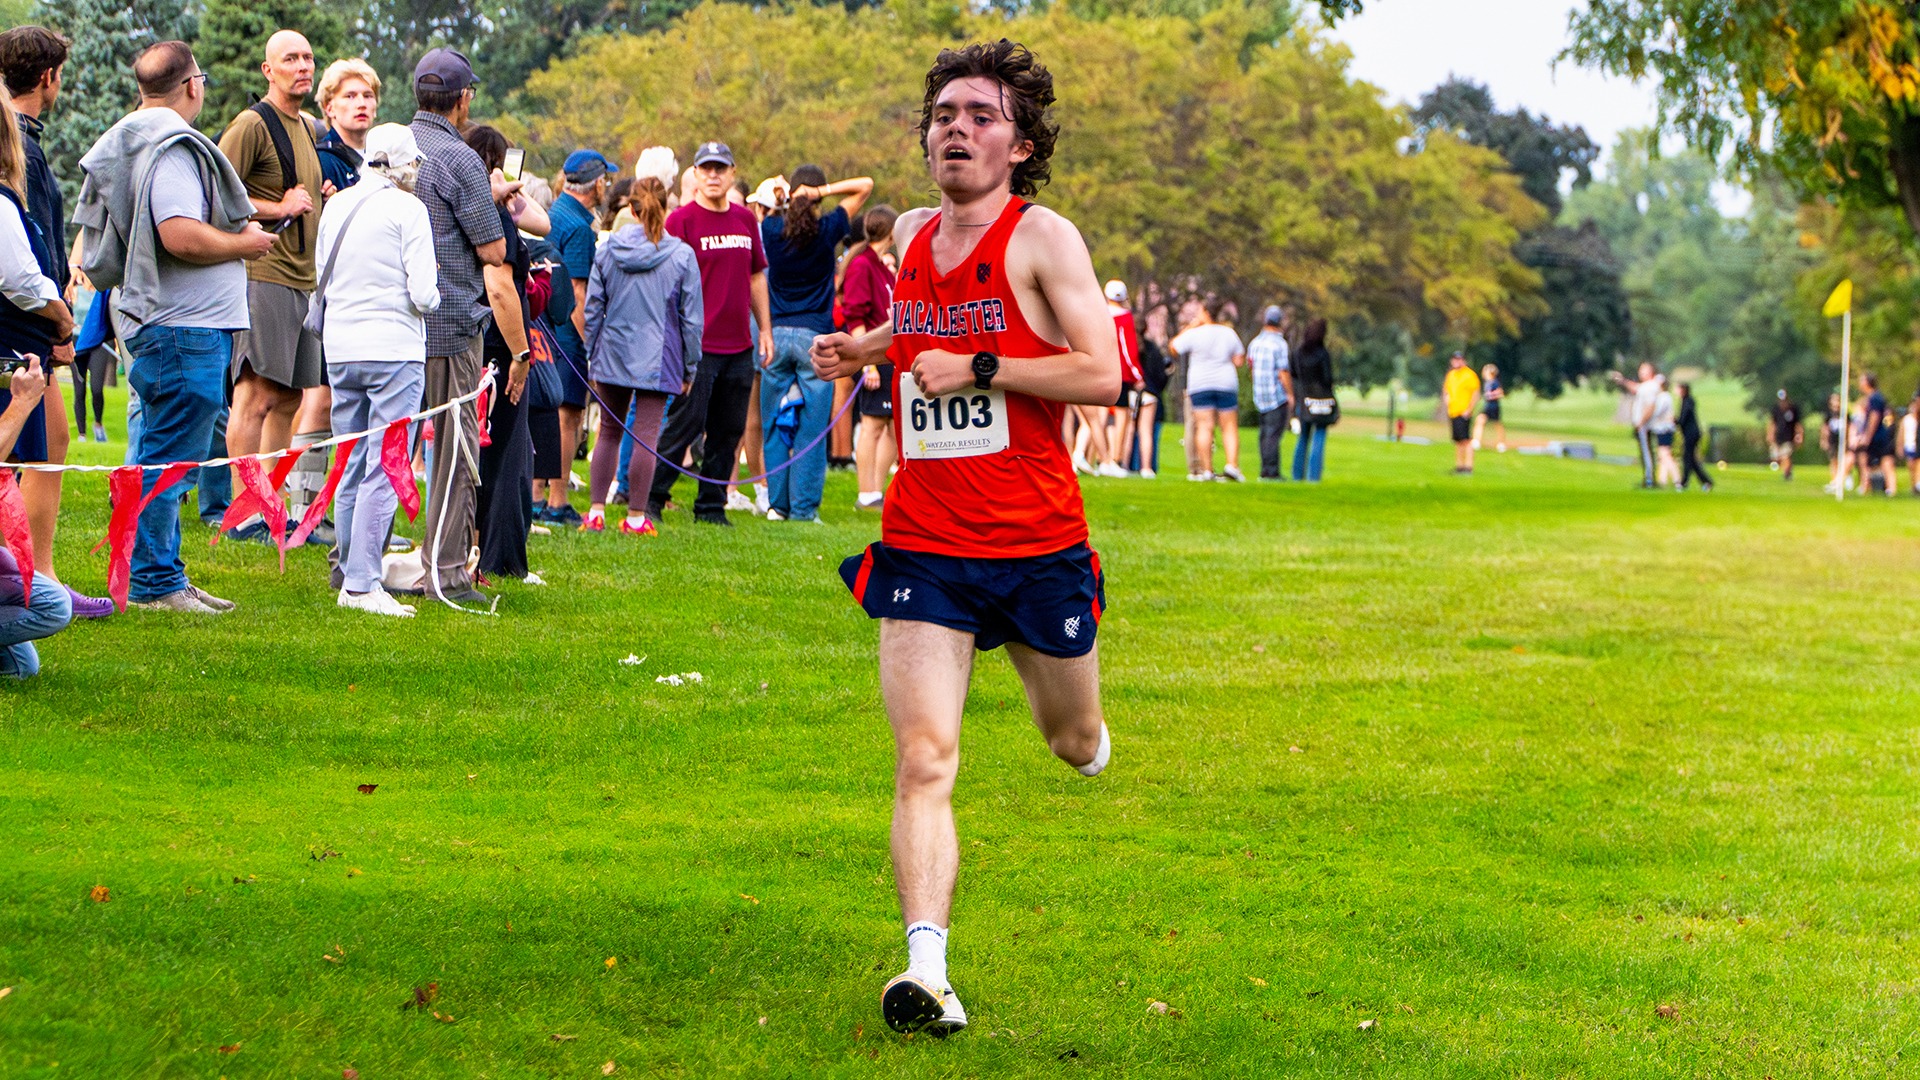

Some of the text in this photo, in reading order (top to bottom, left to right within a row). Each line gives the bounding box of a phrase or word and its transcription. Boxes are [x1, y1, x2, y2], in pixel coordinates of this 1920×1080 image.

[911, 395, 993, 431] 6103
[925, 441, 956, 450] WAYZATA
[958, 438, 991, 447] RESULTS
